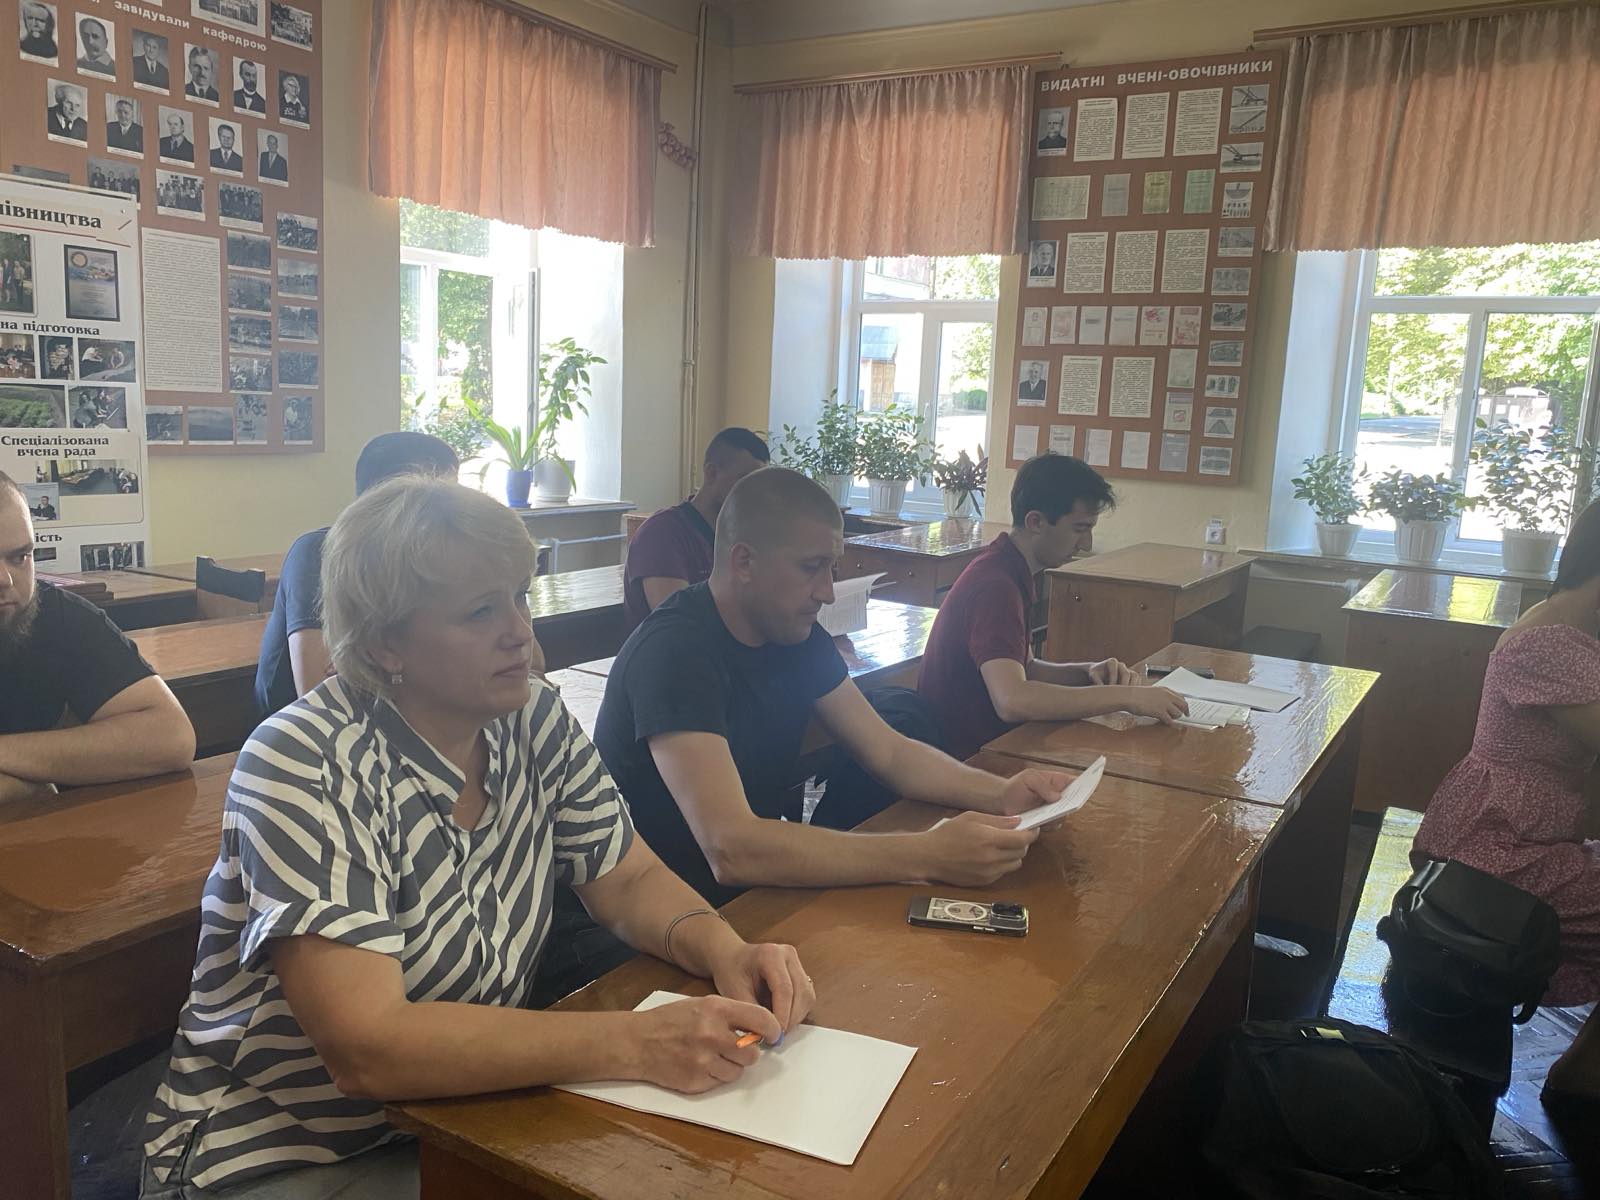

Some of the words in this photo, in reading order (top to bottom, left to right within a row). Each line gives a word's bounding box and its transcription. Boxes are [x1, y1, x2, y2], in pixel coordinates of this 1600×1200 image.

[114, 0, 190, 29] завідували
[203, 25, 267, 52] кафедрою
[1040, 75, 1105, 92] ВИДАТНІ
[1117, 60, 1273, 85] ВЧЕНІ-ОВОЧІВНИКИ
[23, 321, 100, 335] підготовка
[1, 435, 109, 448] Спеціалізована
[17, 448, 59, 456] вчена
[64, 448, 96, 458] рада
[35, 533, 62, 543] ість
